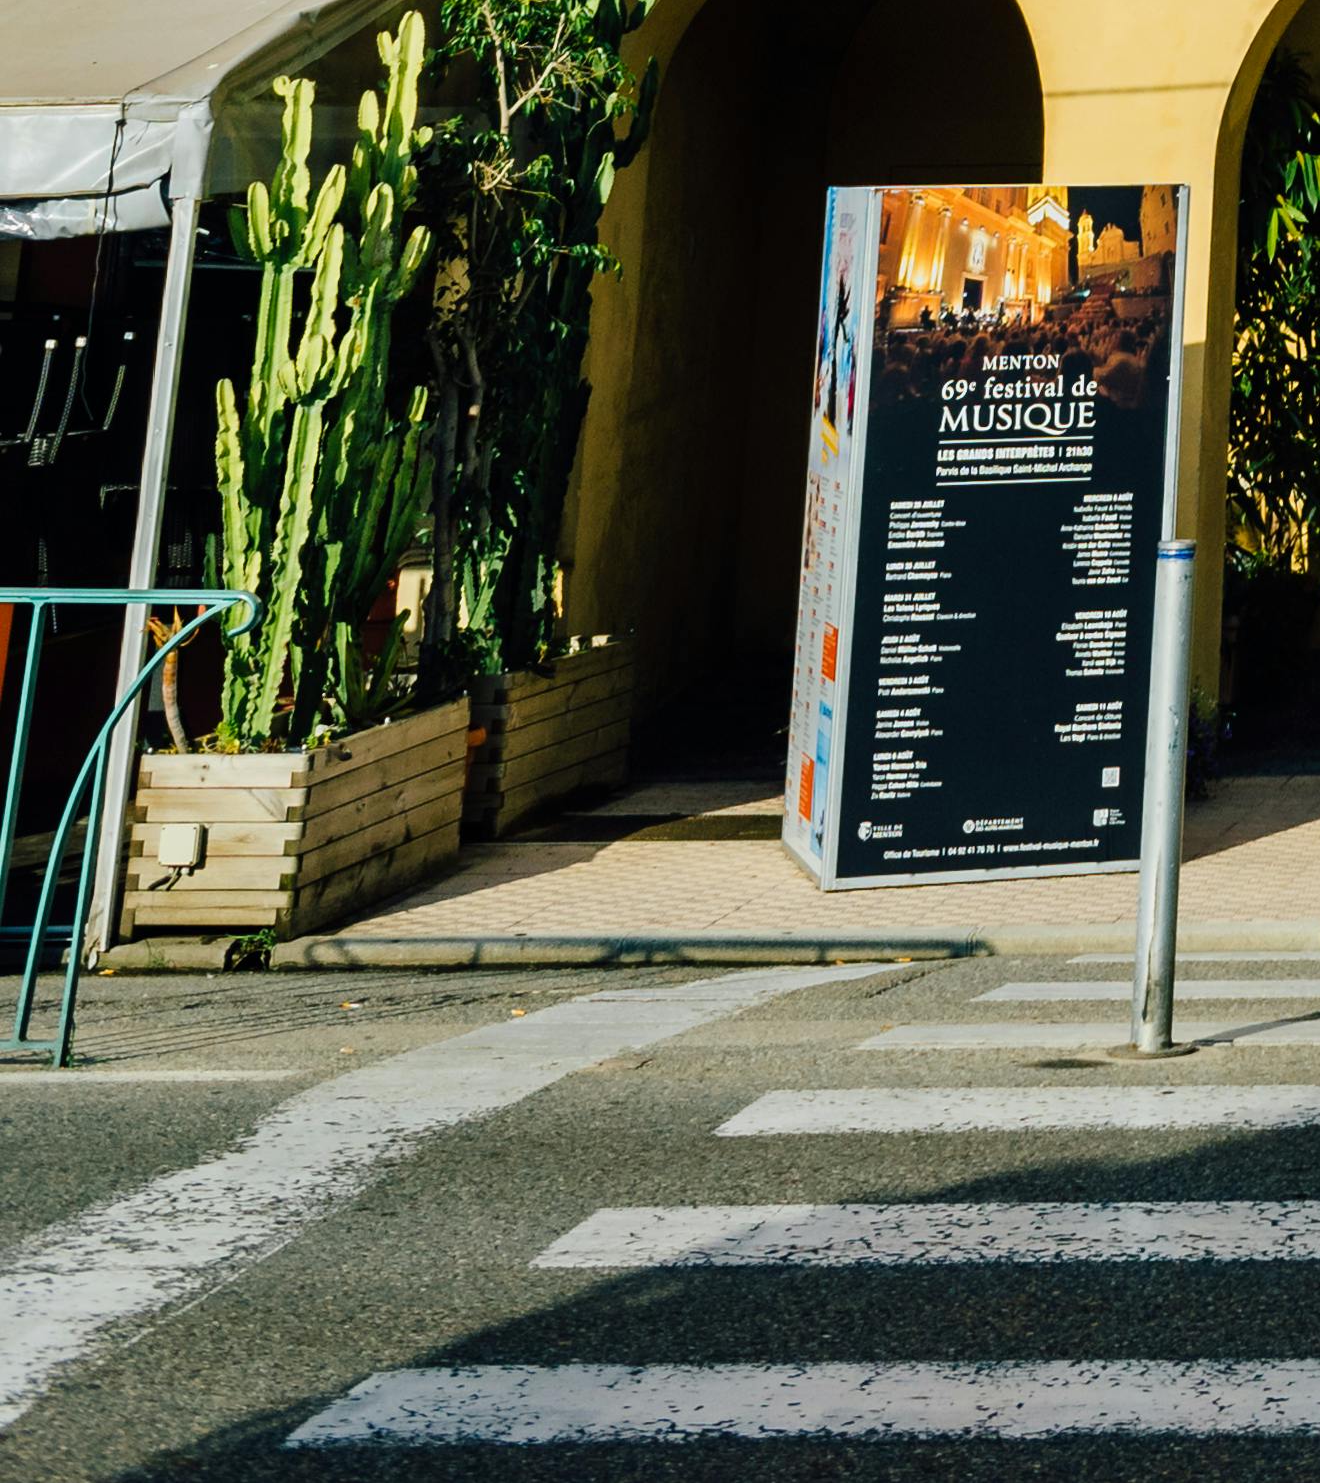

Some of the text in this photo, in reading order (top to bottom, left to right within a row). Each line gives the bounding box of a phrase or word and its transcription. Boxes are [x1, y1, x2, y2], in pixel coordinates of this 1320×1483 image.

[982, 353, 1060, 371] MENTON
[984, 374, 1064, 399] festival
[1070, 374, 1098, 397] de
[938, 401, 1097, 436] MUSIQUE
[936, 449, 954, 462] LES
[956, 448, 994, 462] GRANDS
[1066, 445, 1094, 458] 21h30
[936, 466, 958, 477] Parvis
[960, 466, 970, 476] de
[970, 465, 978, 476] la
[1012, 463, 1058, 474] Saint-Michel
[1058, 462, 1093, 474] Archange
[883, 850, 902, 860] Office
